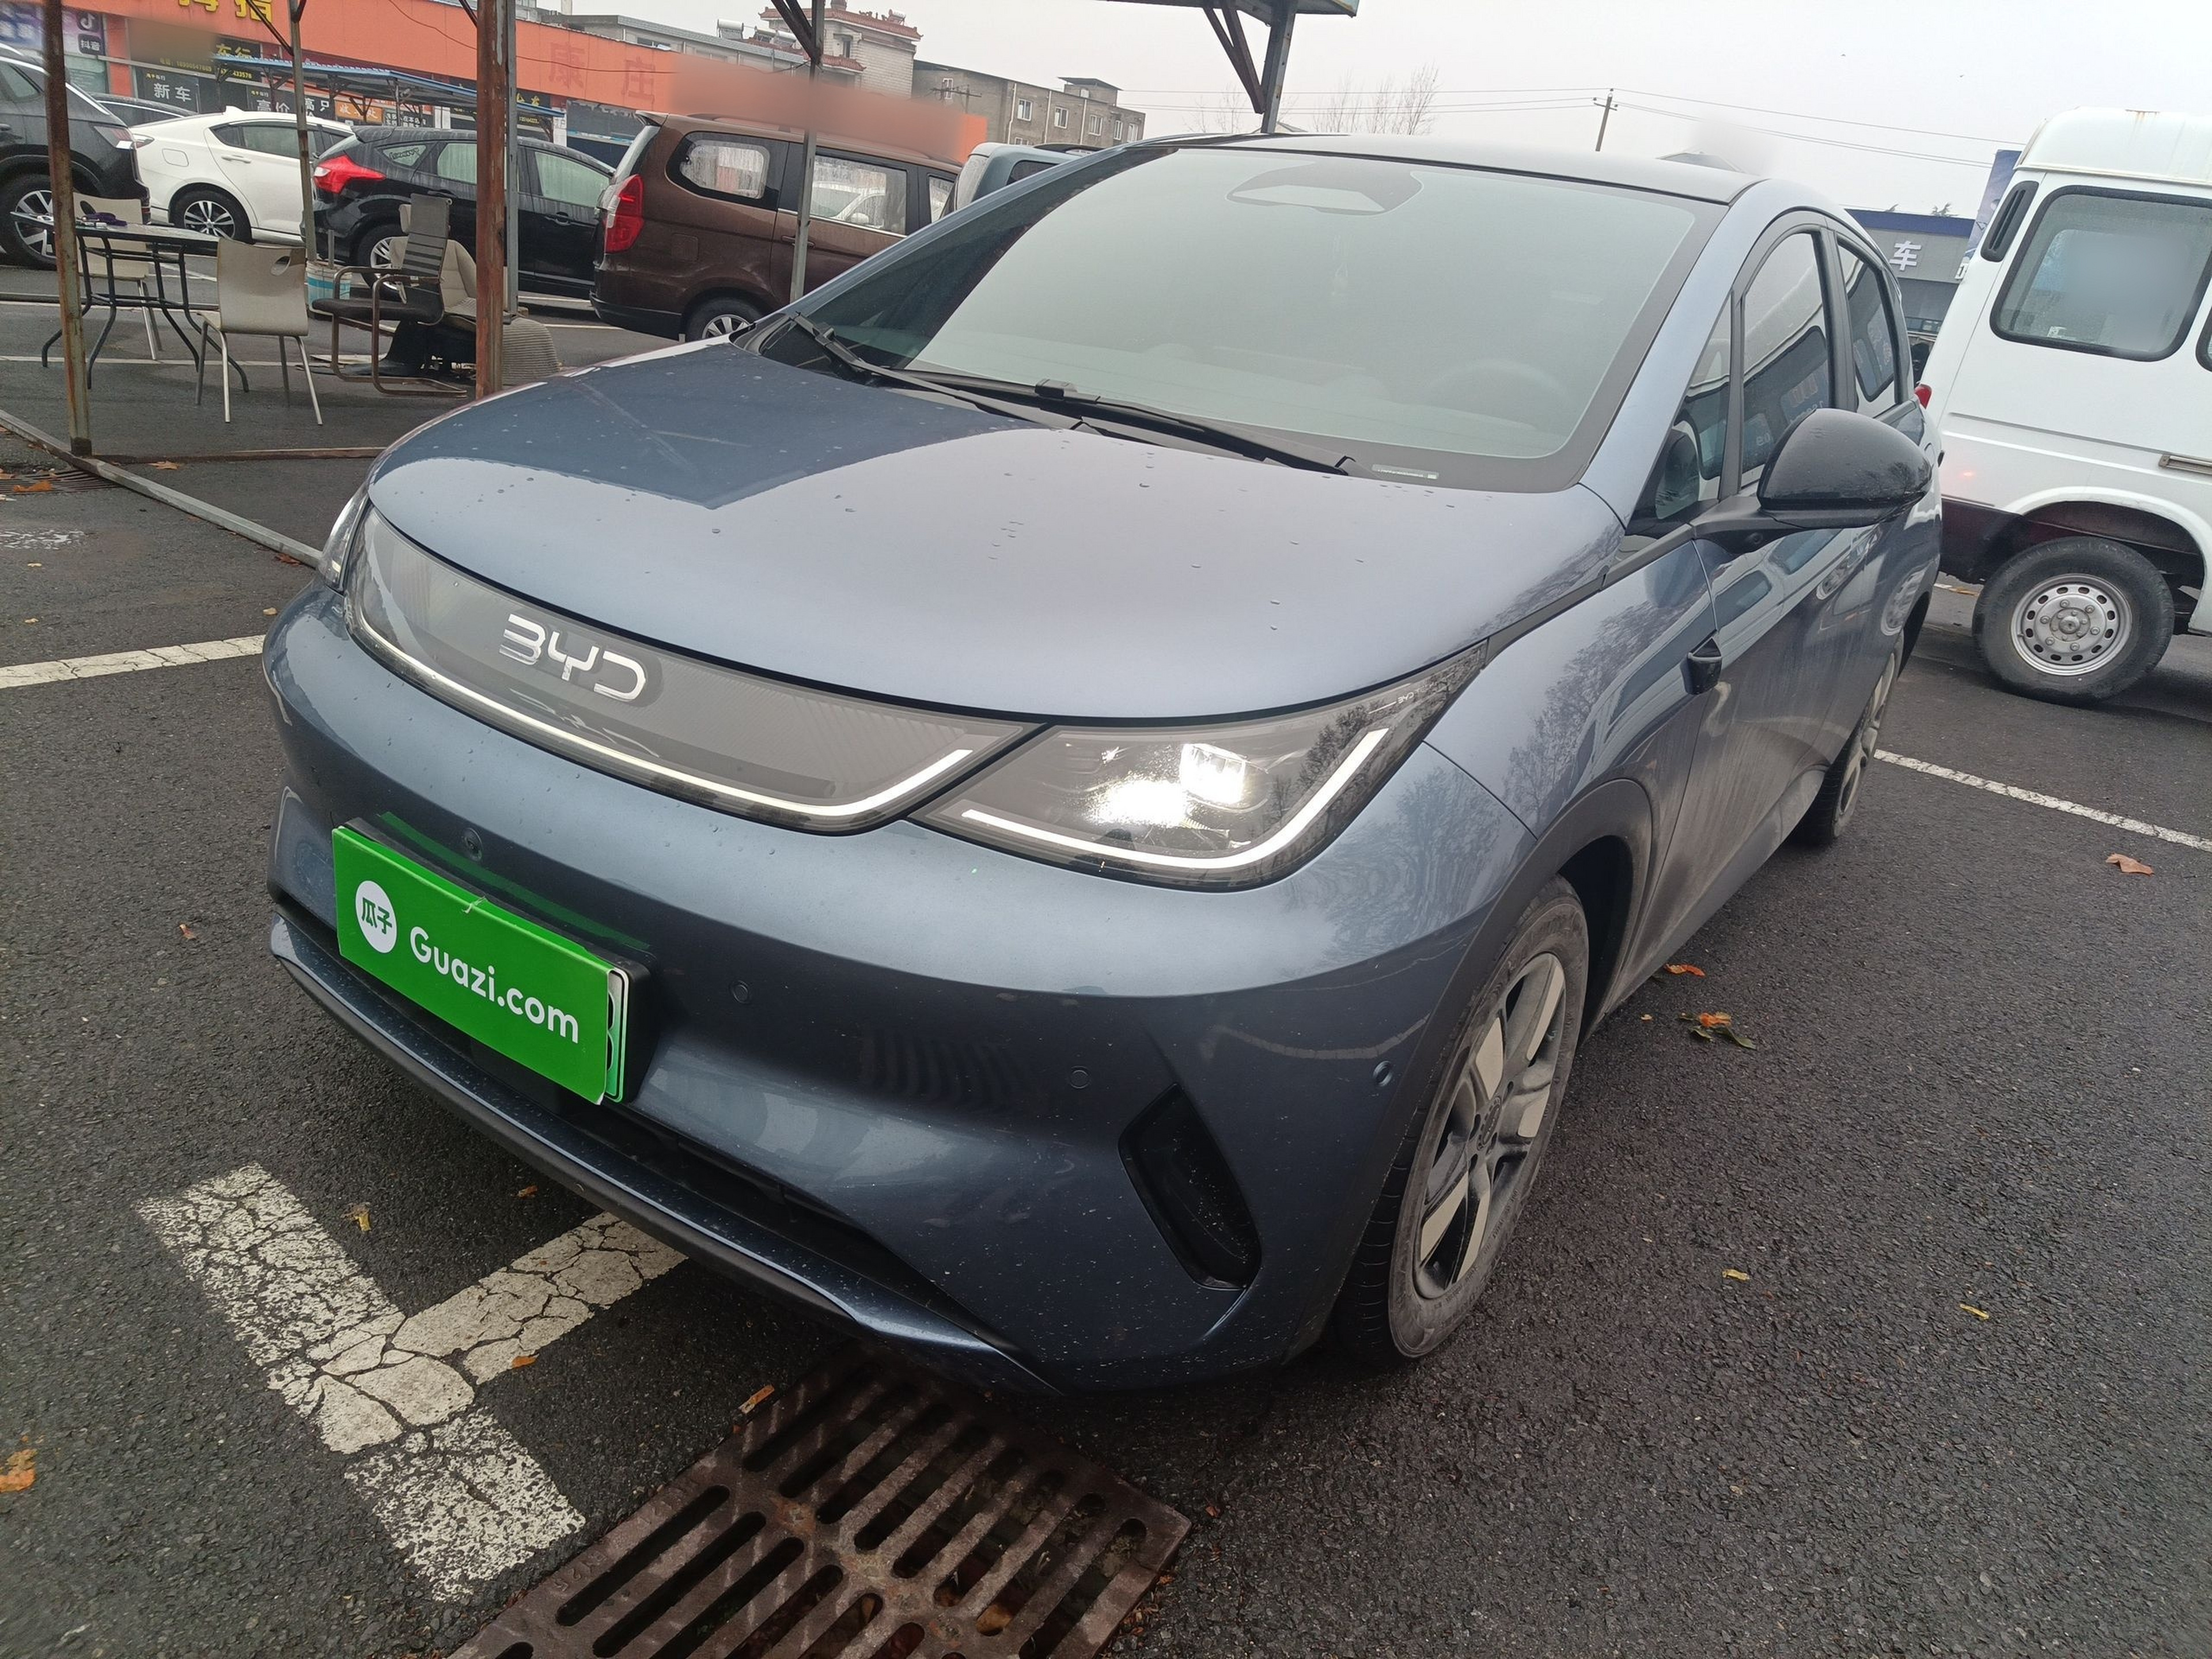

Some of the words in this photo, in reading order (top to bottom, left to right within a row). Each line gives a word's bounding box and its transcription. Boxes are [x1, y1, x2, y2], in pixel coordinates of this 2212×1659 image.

[81, 40, 100, 51] 抖音
[154, 83, 192, 101] 新车
[1889, 240, 1922, 271] 车
[499, 613, 646, 702] BYD
[1397, 692, 1414, 704] BYD
[361, 897, 392, 934] 瓜子
[410, 926, 578, 1043] Guazi.com
